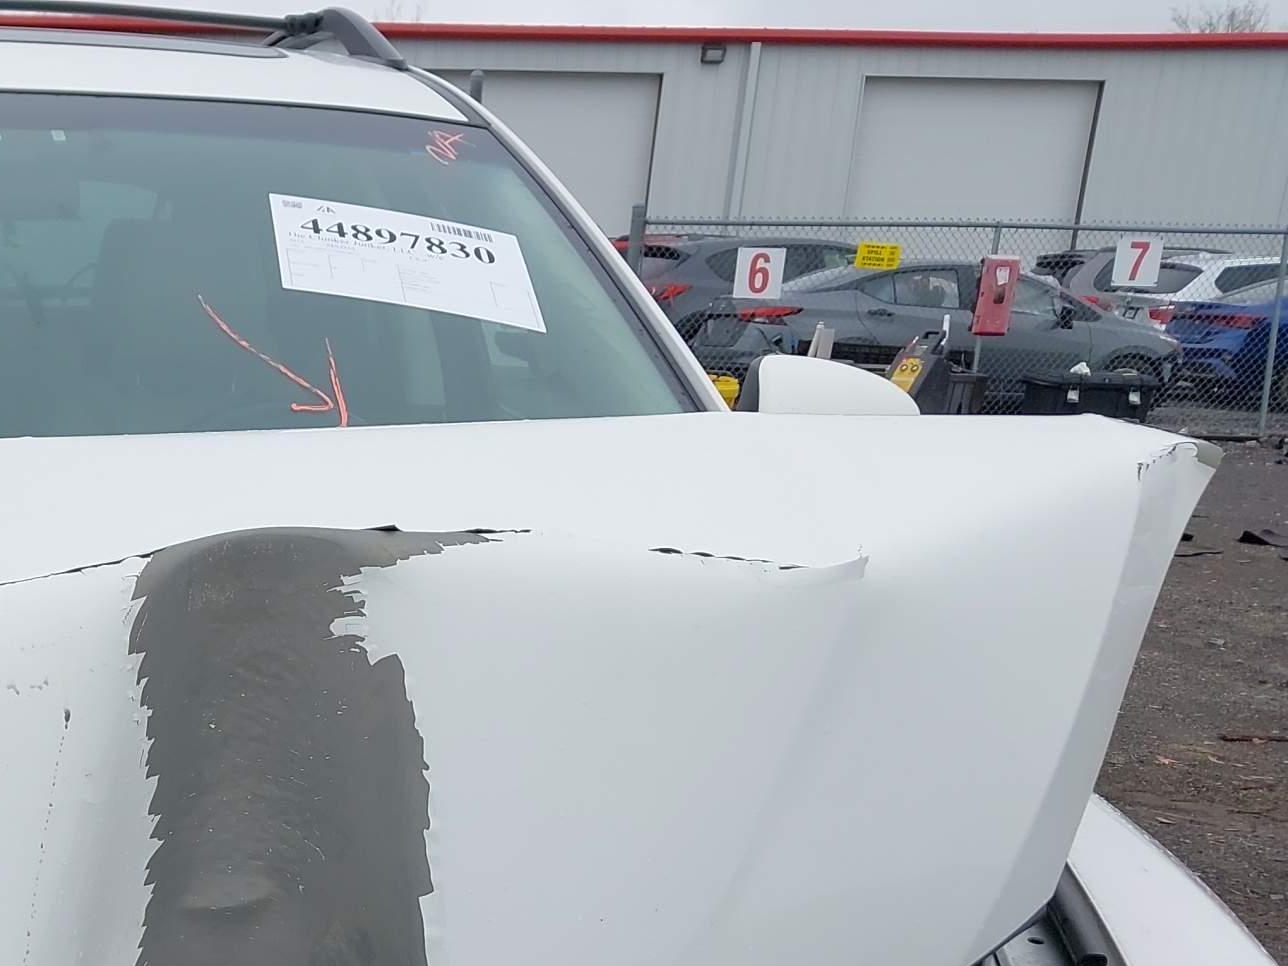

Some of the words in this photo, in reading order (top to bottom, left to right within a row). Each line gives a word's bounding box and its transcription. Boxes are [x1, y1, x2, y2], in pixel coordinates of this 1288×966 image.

[300, 218, 496, 264] 44897830
[1128, 240, 1151, 281] 7
[748, 252, 771, 294] 6
